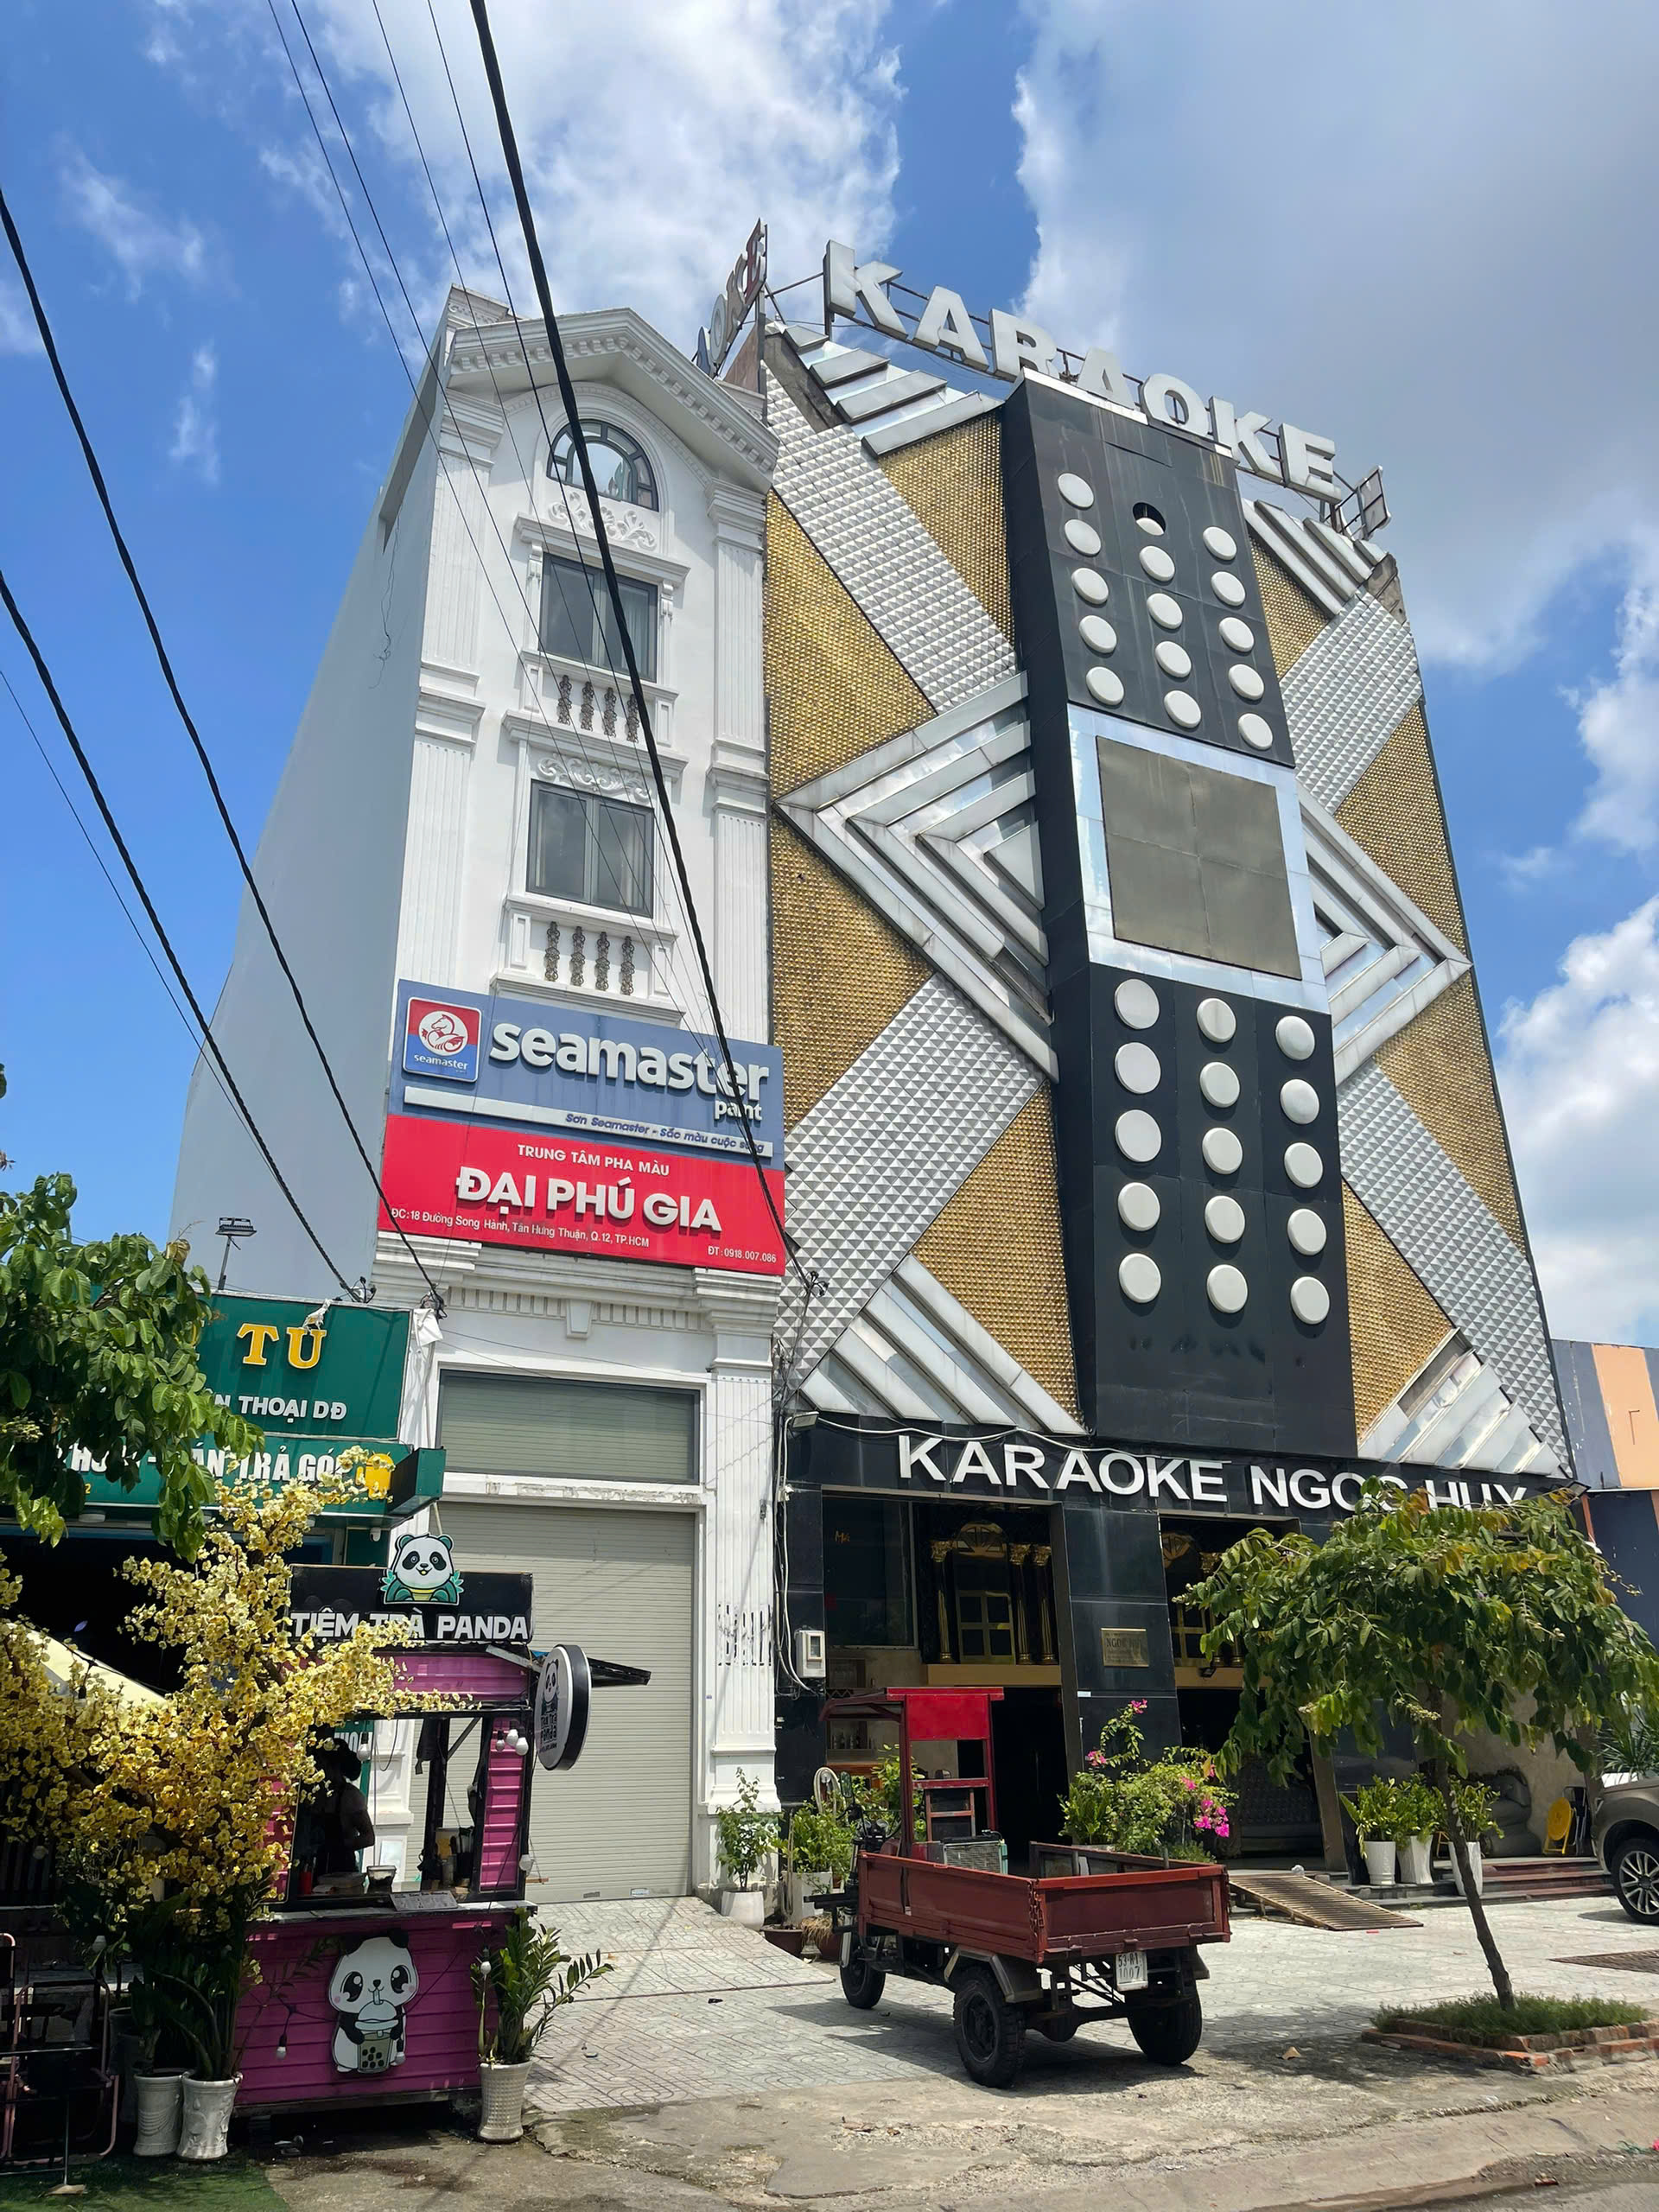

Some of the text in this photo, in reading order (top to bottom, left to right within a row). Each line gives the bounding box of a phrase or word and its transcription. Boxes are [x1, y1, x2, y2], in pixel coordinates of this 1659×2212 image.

[824, 239, 1343, 505] KARAOKE
[413, 1054, 468, 1071] seamaster
[488, 1023, 769, 1101] seamaster
[715, 1099, 763, 1121] pant
[565, 1114, 588, 1125] Sơn
[591, 1116, 650, 1135] Seamaster
[660, 1127, 681, 1140] Sắc
[683, 1132, 709, 1145] màu
[711, 1136, 737, 1150] cuộc
[517, 1143, 670, 1176] TRUNG TÂM PHA MÀU
[455, 1166, 723, 1232] ĐẠI PHÚ GIA
[422, 1211, 454, 1227] Đường
[455, 1216, 480, 1230] Song
[484, 1218, 510, 1233] Hành,
[531, 1224, 555, 1238] Hưng
[614, 1233, 650, 1248] TP.HCM
[238, 1395, 308, 1423] THOẠI
[313, 1401, 346, 1421] DĐ
[899, 1434, 1229, 1503] KARAOKE
[290, 1606, 359, 1643] TIỆM
[437, 1615, 529, 1640] PANDA
